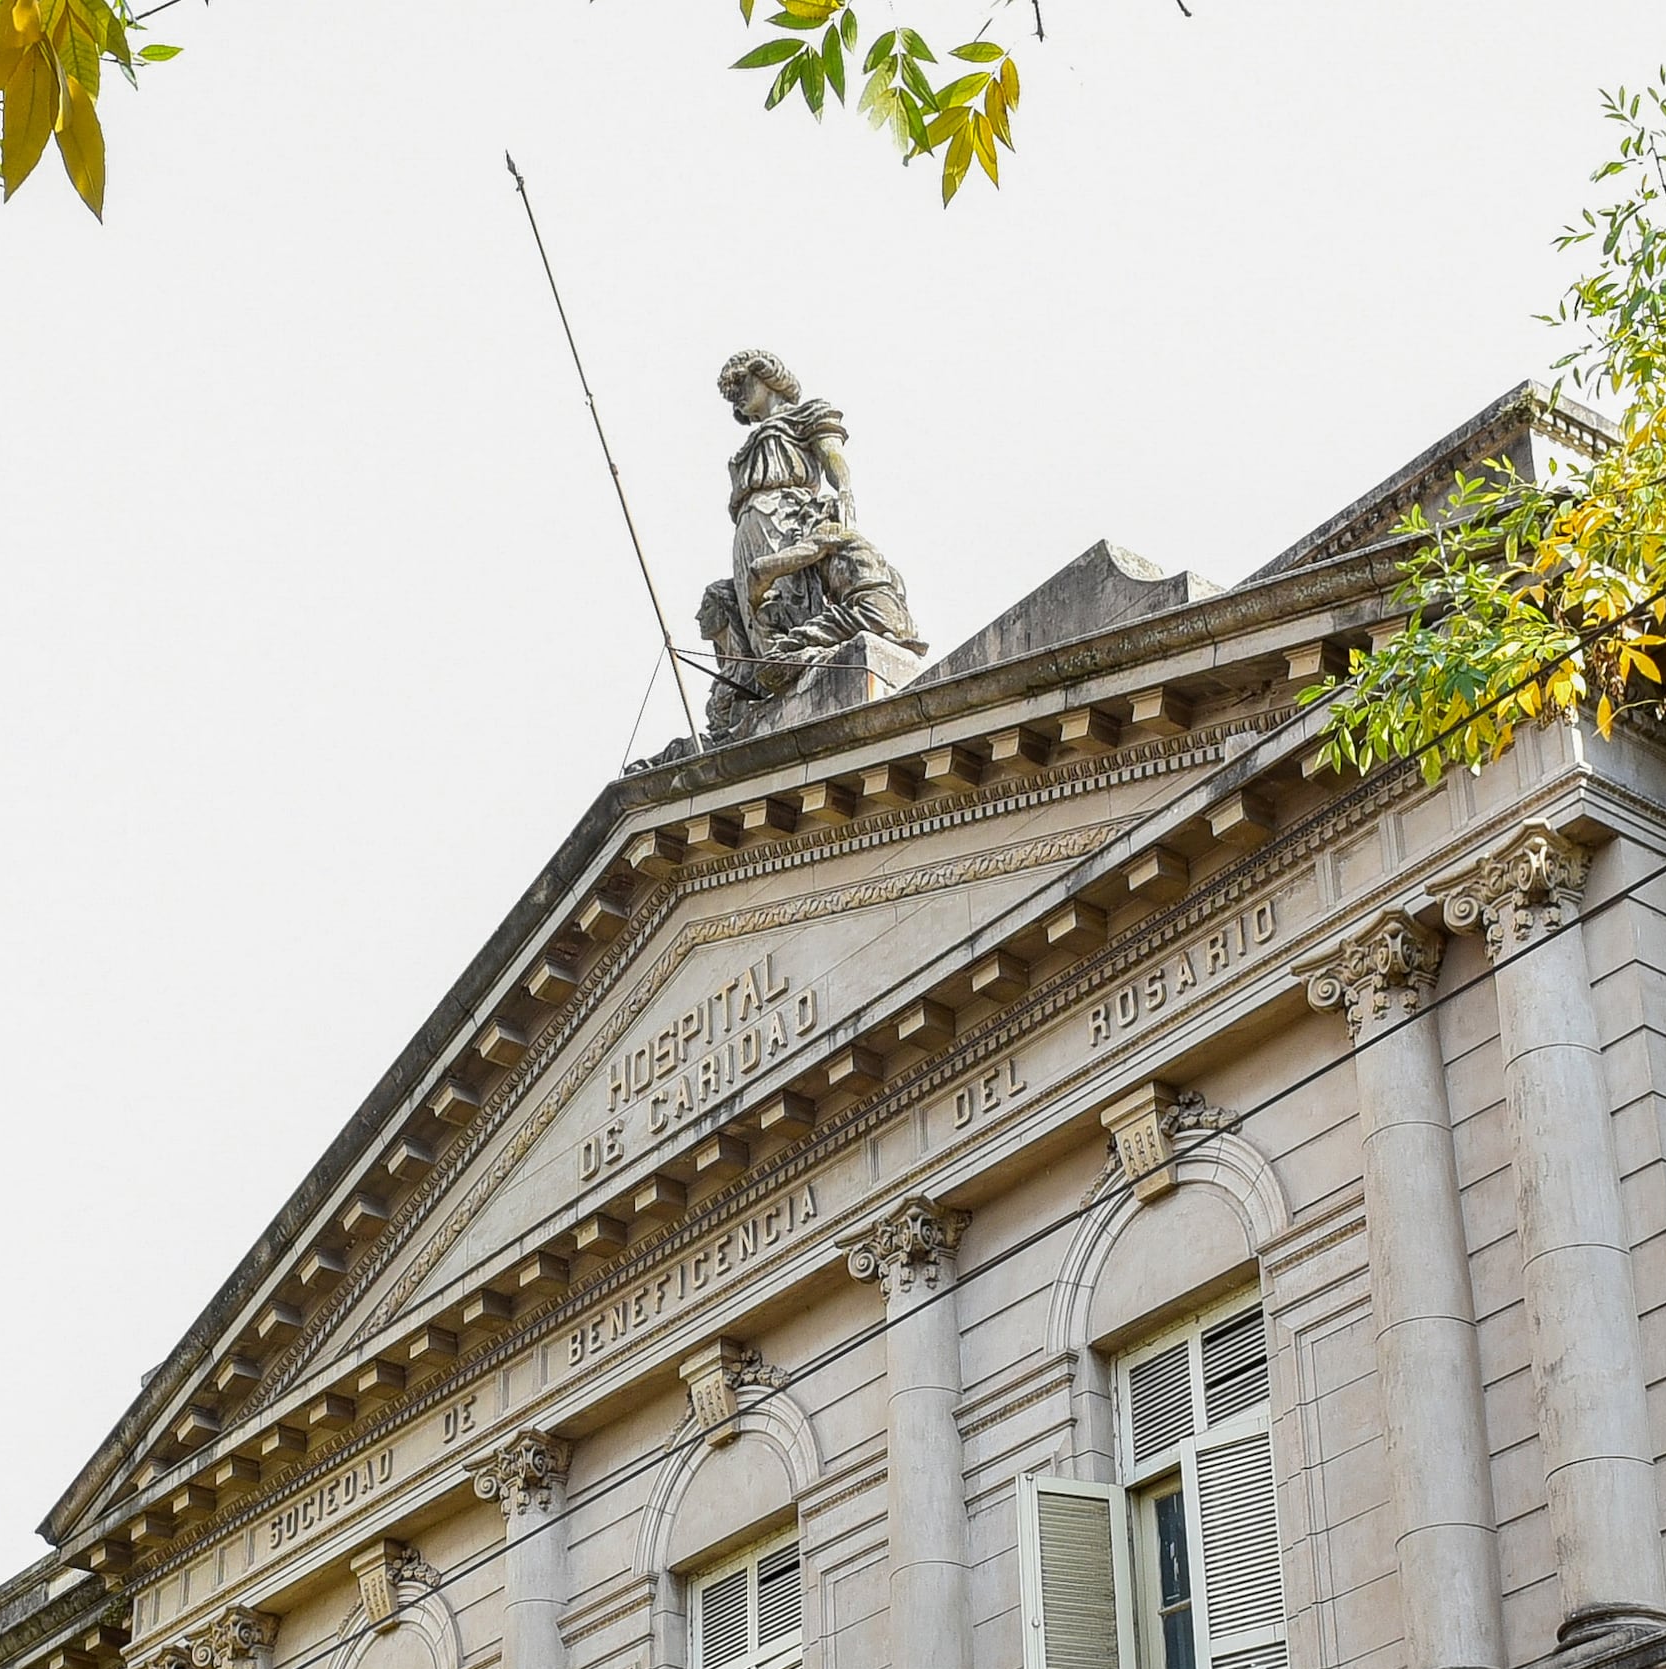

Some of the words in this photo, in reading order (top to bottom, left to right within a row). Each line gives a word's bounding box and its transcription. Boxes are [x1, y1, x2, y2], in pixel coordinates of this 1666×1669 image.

[581, 1118, 625, 1182] DE
[648, 987, 818, 1135] CARIDAD
[607, 952, 790, 1112] HOSPITAL
[270, 1448, 394, 1549] SOCIEDAD
[443, 1395, 478, 1444] DE
[567, 1183, 819, 1367] BENEFICENCIA
[953, 1057, 1028, 1130] DEL
[1087, 899, 1277, 1048] ROSARIO
